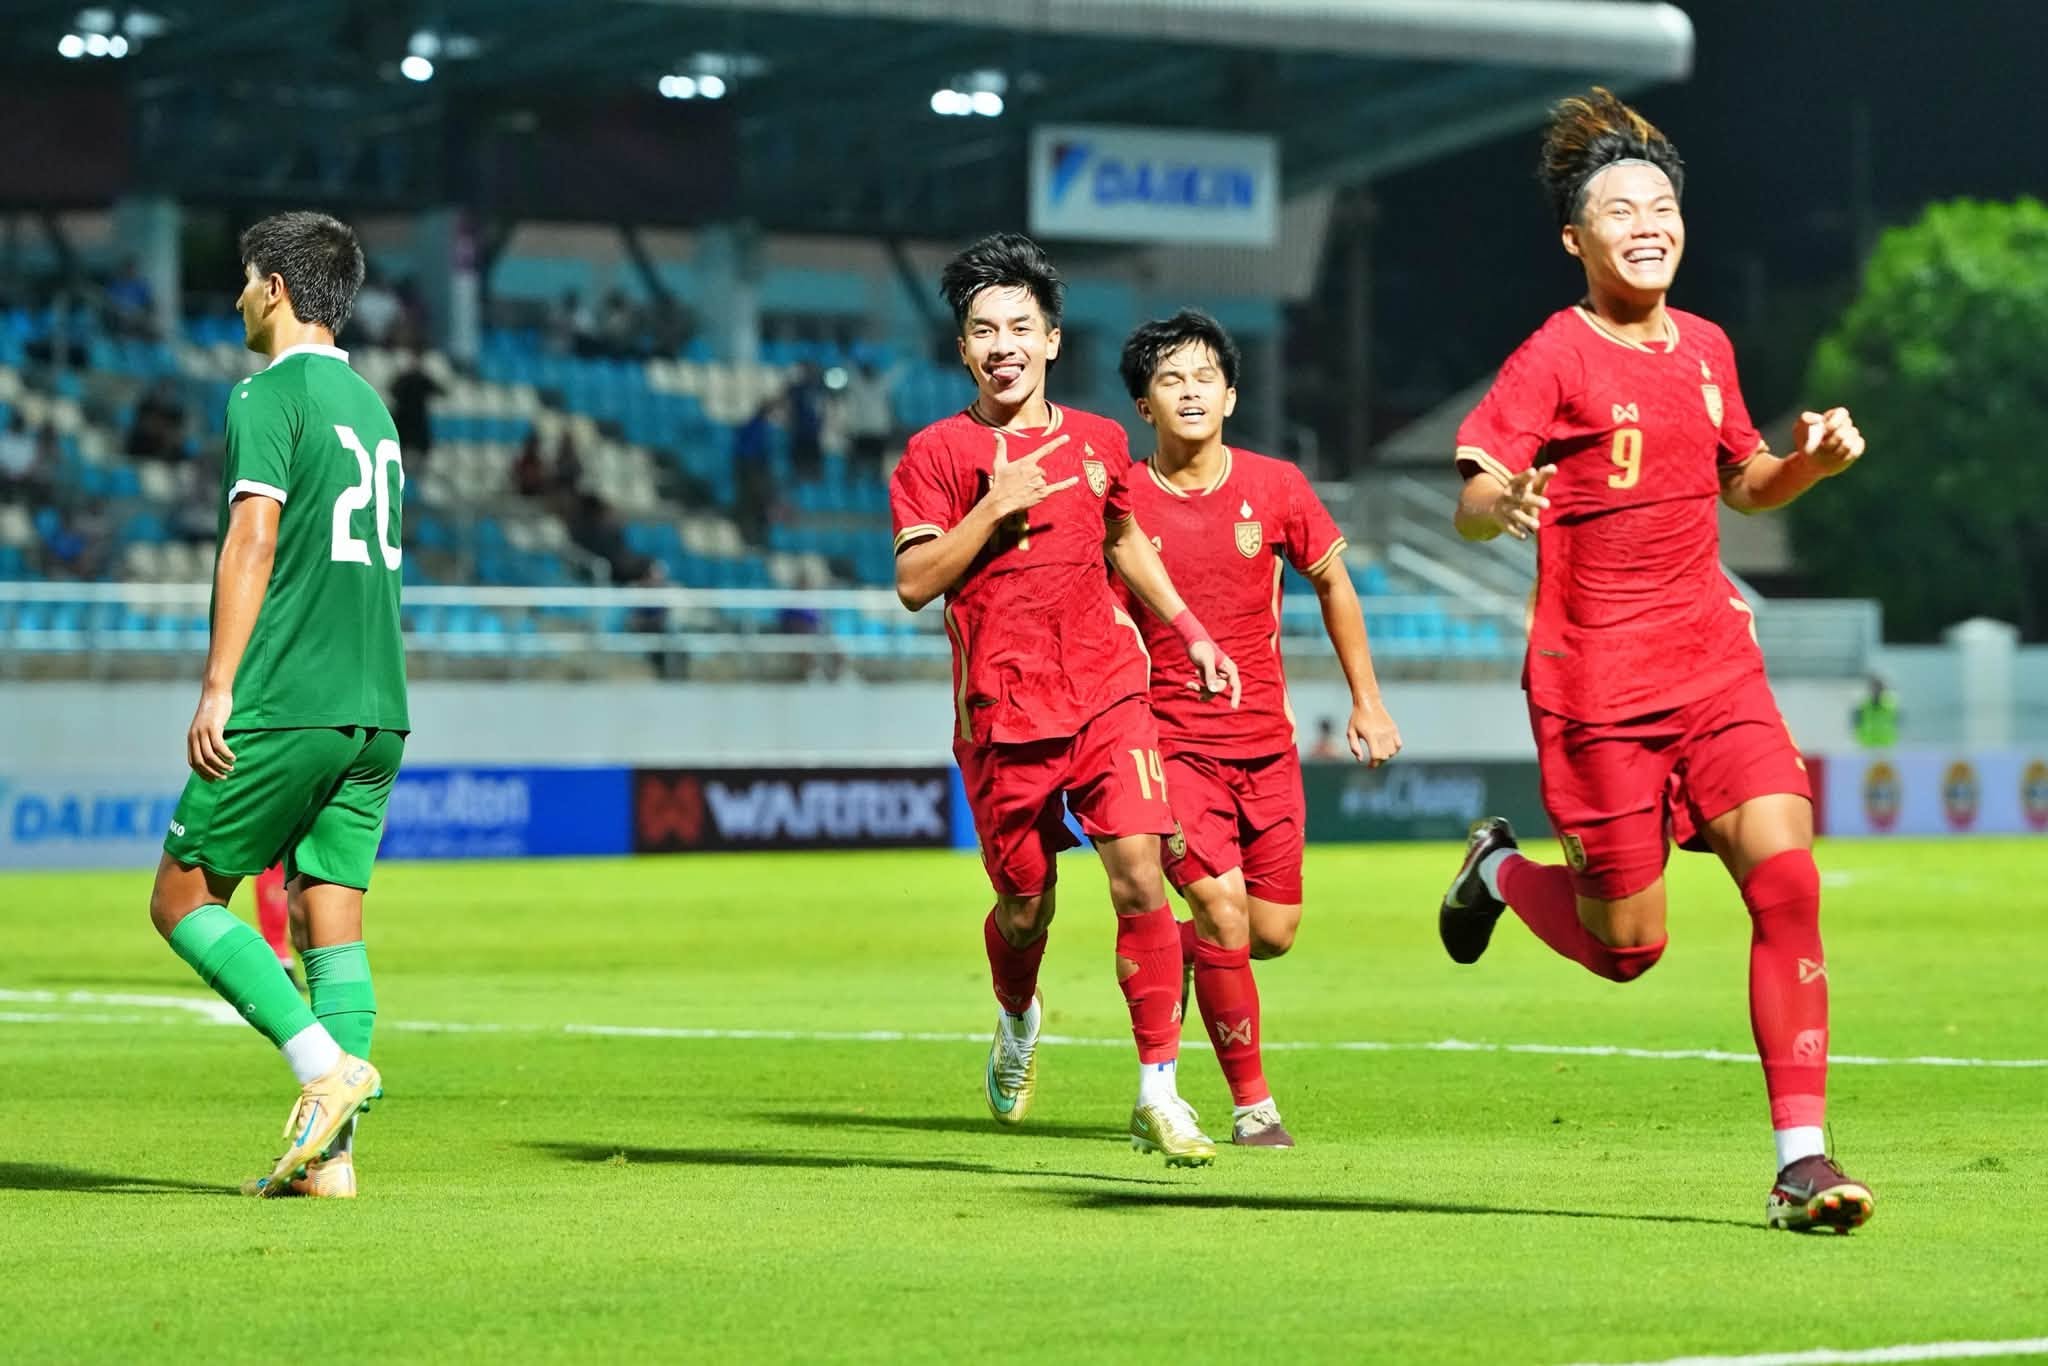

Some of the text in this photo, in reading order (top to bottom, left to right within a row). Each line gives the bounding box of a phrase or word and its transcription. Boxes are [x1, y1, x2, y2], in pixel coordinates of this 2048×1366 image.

[1094, 159, 1253, 208] DAIKIN
[1608, 428, 1642, 489] 9
[331, 424, 405, 571] 20
[1127, 748, 1167, 803] 14
[13, 795, 179, 842] DAIKI
[170, 820, 186, 837] AKO
[706, 781, 944, 838] WARRIX
